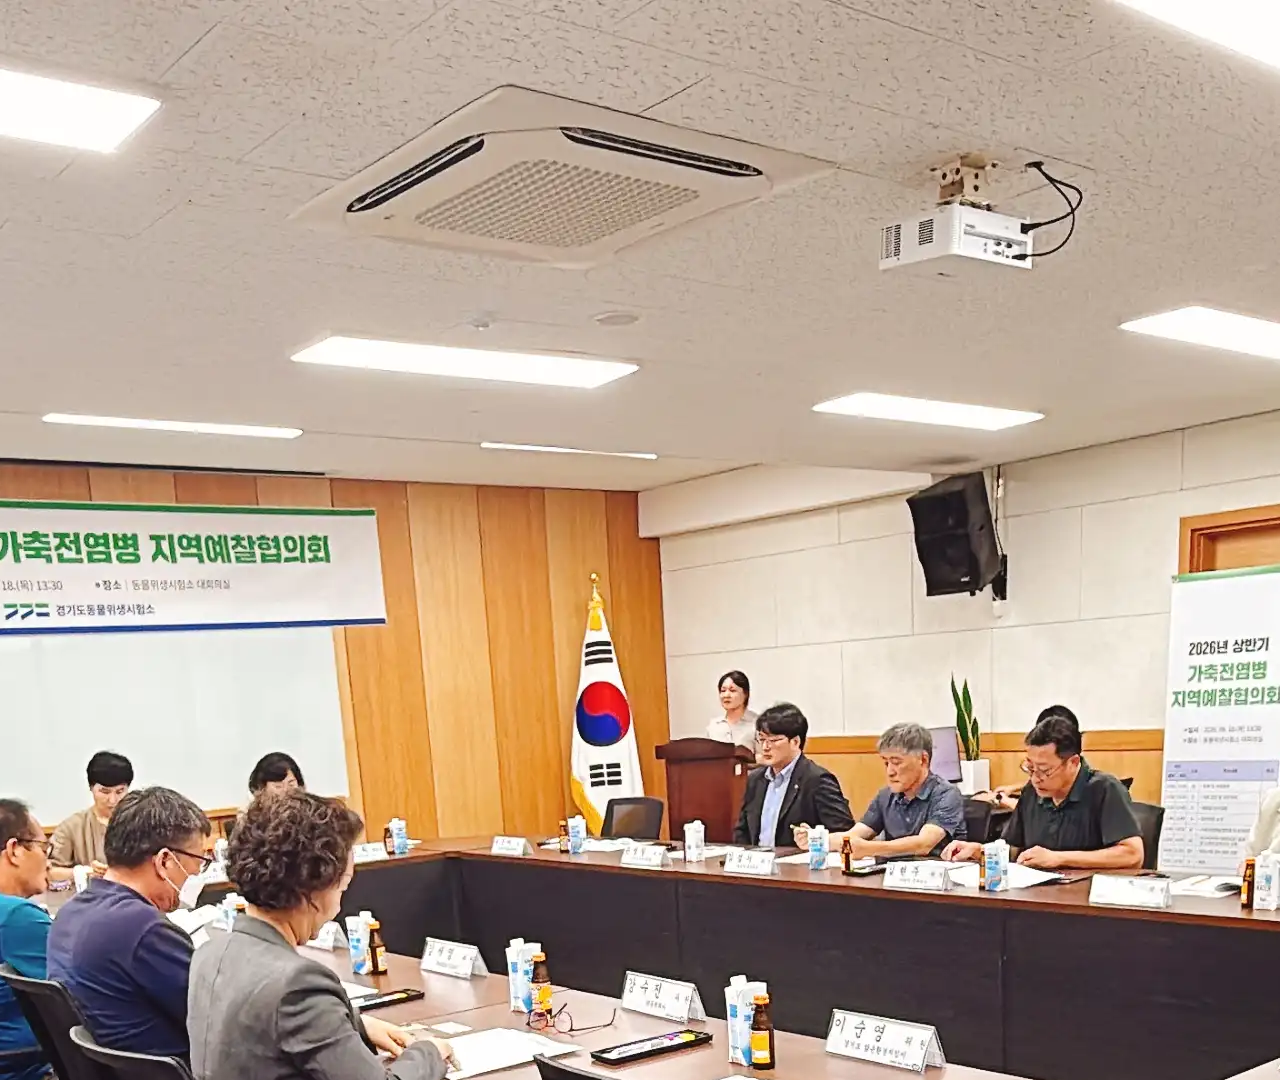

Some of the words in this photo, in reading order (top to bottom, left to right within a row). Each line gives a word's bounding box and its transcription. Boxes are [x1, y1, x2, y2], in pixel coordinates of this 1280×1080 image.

[149, 533, 332, 564] 지역예찰협의회
[102, 579, 122, 591] 장소
[131, 579, 195, 591] 동물위생시험소
[56, 603, 156, 617] 경기도동물위생시험소
[1189, 639, 1228, 657] 2026년
[1232, 637, 1270, 654] 상반기
[1187, 660, 1268, 684] 가축전염병
